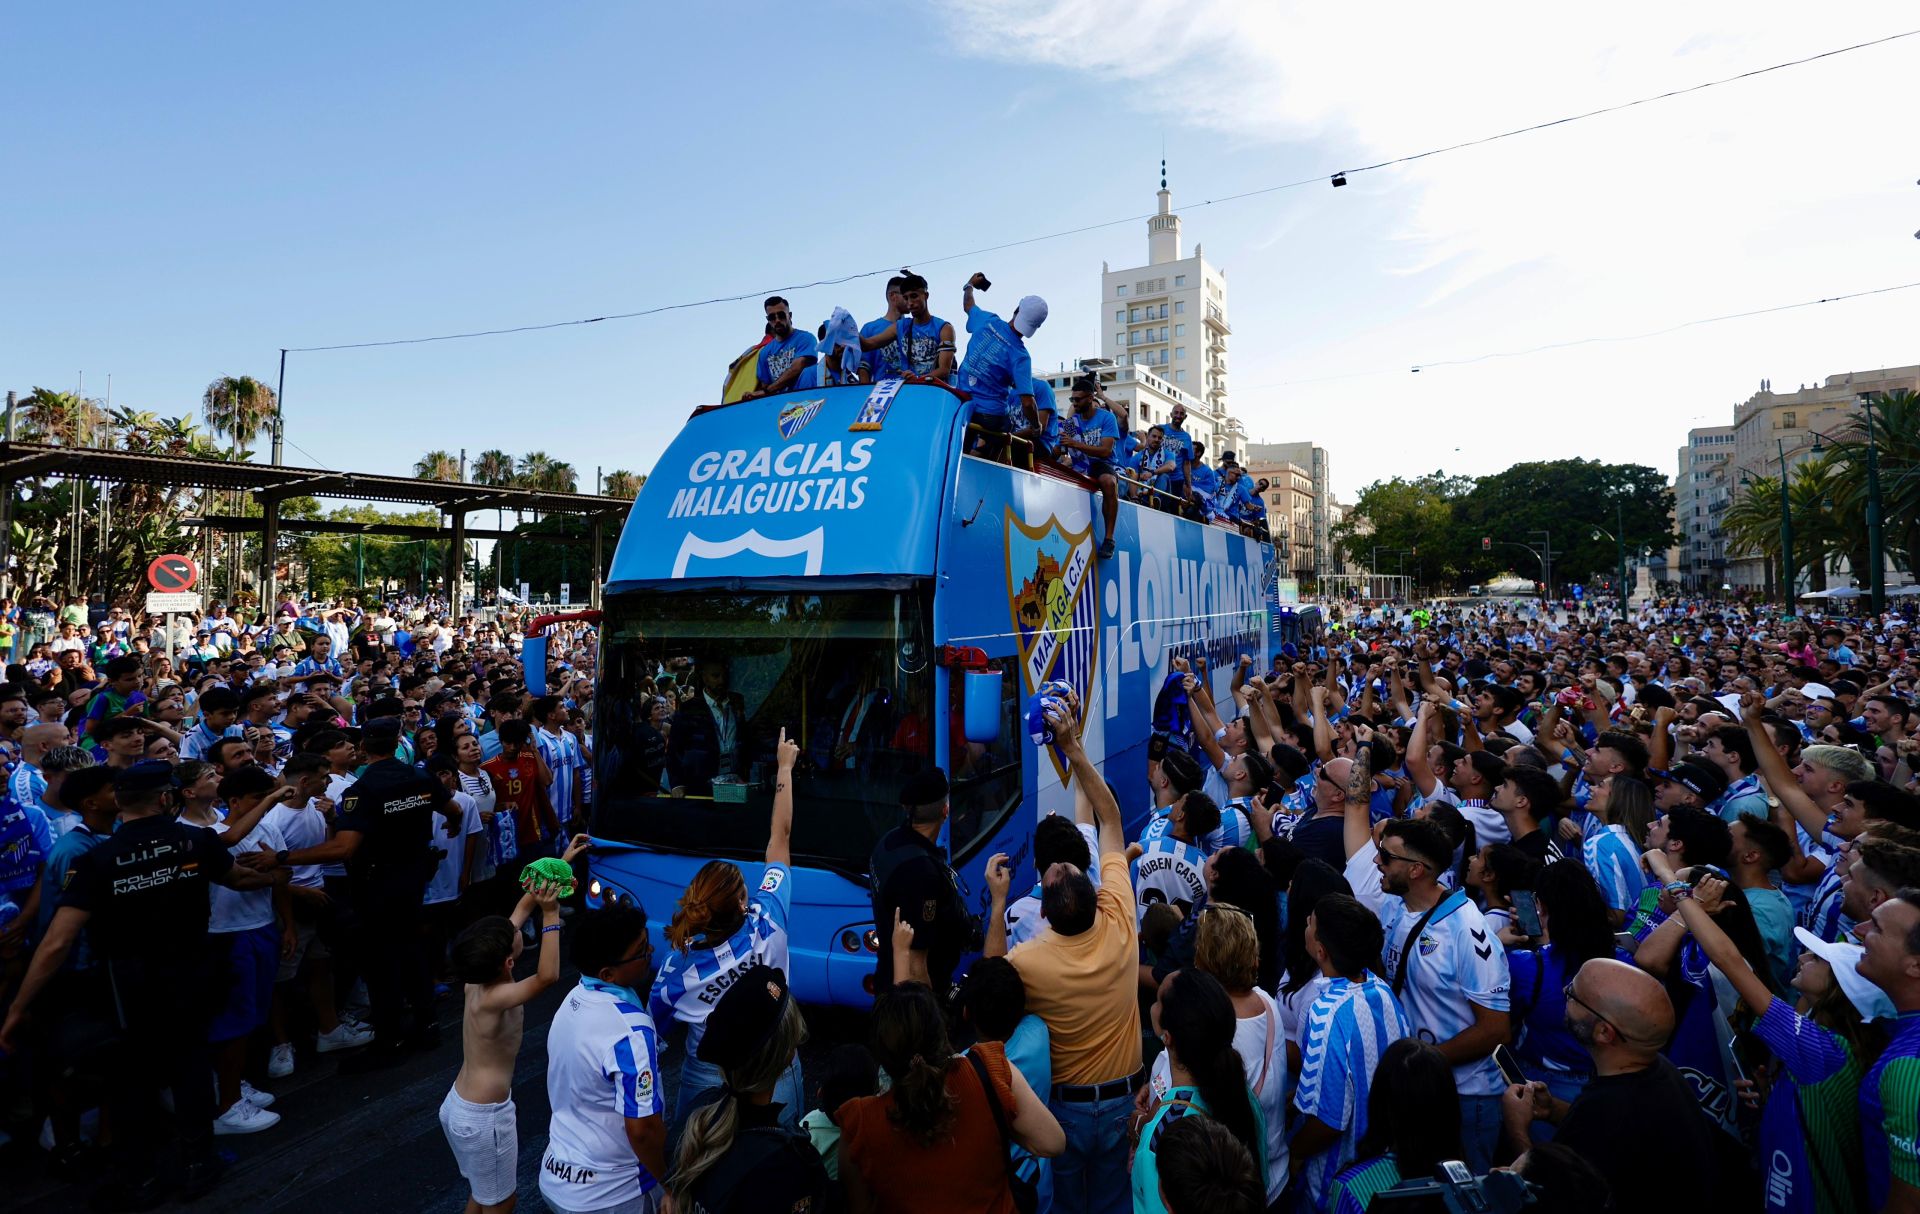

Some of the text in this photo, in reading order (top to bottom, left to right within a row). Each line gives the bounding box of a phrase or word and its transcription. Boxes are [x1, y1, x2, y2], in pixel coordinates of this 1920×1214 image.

[689, 438, 876, 483] GRACIAS
[668, 476, 868, 519] MALAGUISTAS
[1032, 550, 1086, 677] MALAGA C.F.
[506, 780, 523, 796] 19
[384, 799, 431, 815] NACIONAL
[115, 844, 179, 867] U.I.P.
[113, 871, 199, 896] NACIONAL
[1139, 857, 1205, 900] RUBEN CASTRO
